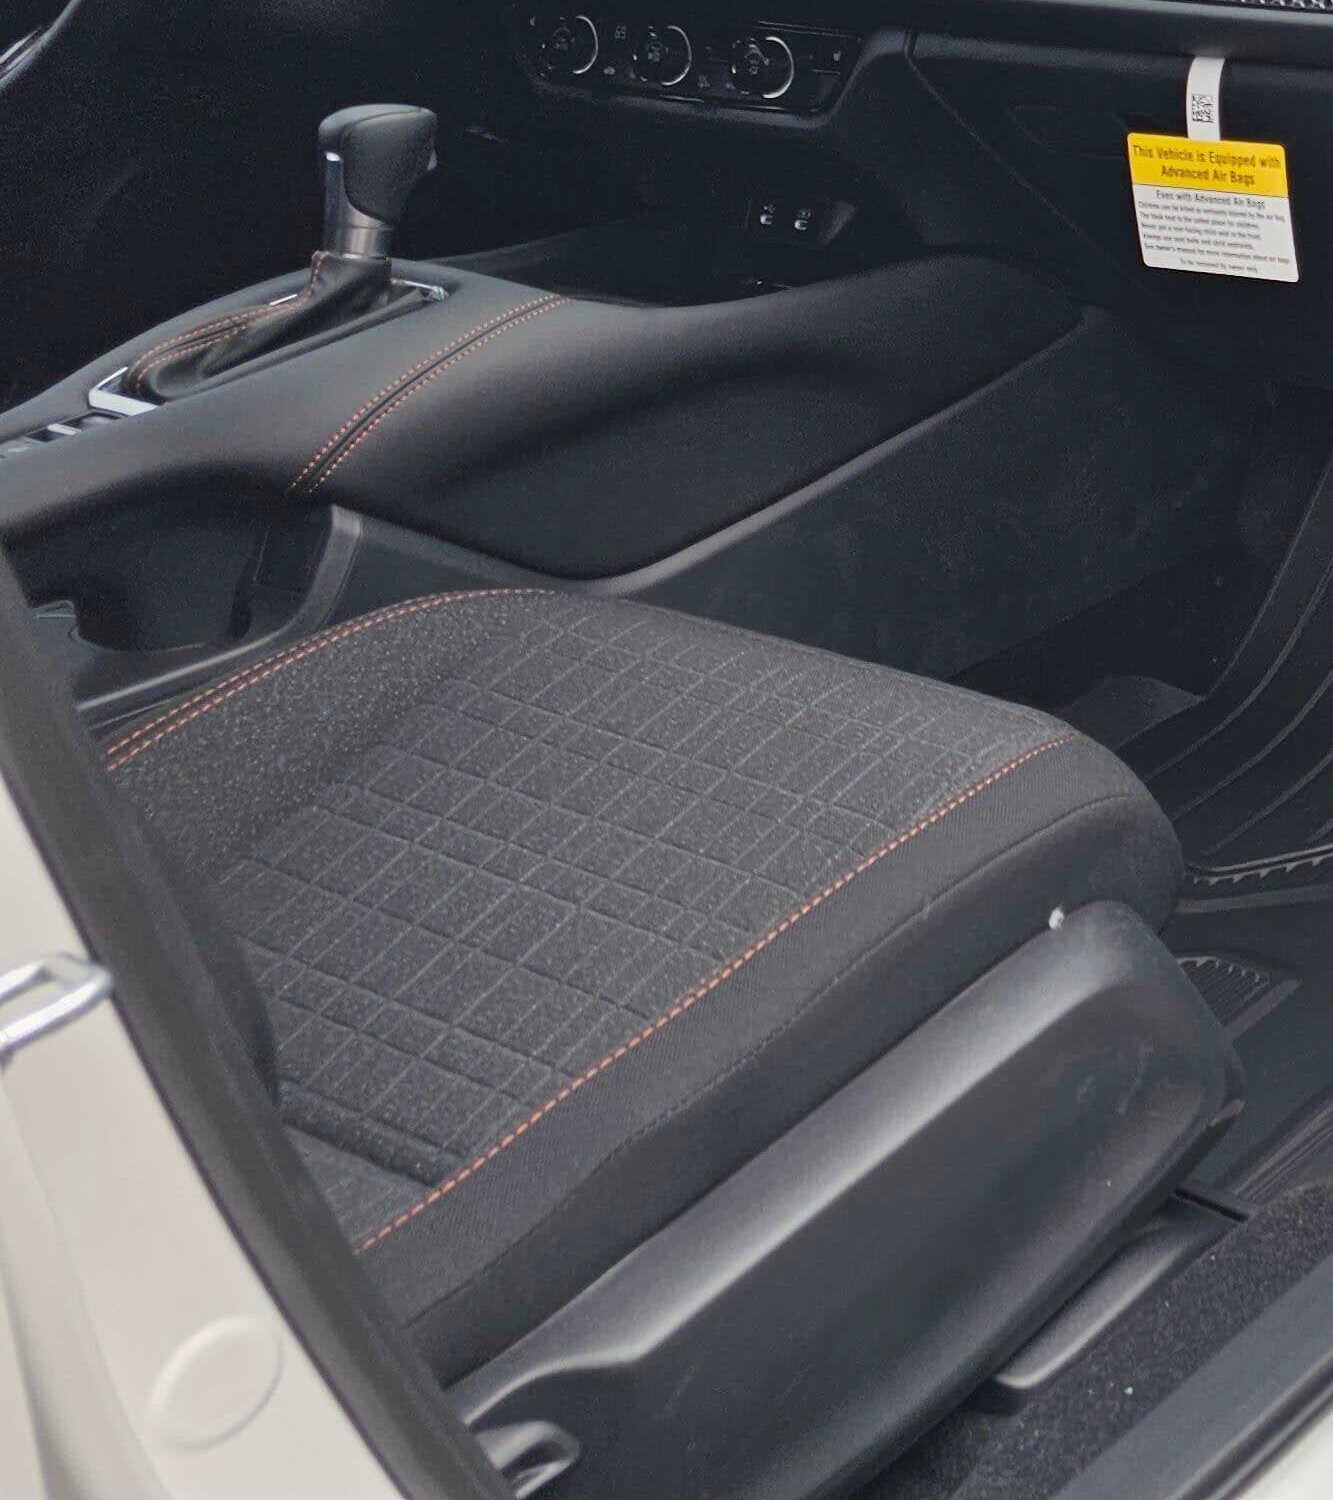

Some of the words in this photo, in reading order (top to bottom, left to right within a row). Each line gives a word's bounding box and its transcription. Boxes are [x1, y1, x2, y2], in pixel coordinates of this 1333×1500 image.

[1133, 145, 1153, 159] This
[1158, 147, 1193, 162] Vehicle
[1197, 151, 1206, 163] is
[1209, 152, 1256, 168] Equipped
[1260, 155, 1281, 170] with
[1161, 165, 1210, 181] Advanced
[1212, 169, 1227, 182] Air
[1230, 171, 1256, 187] Bags
